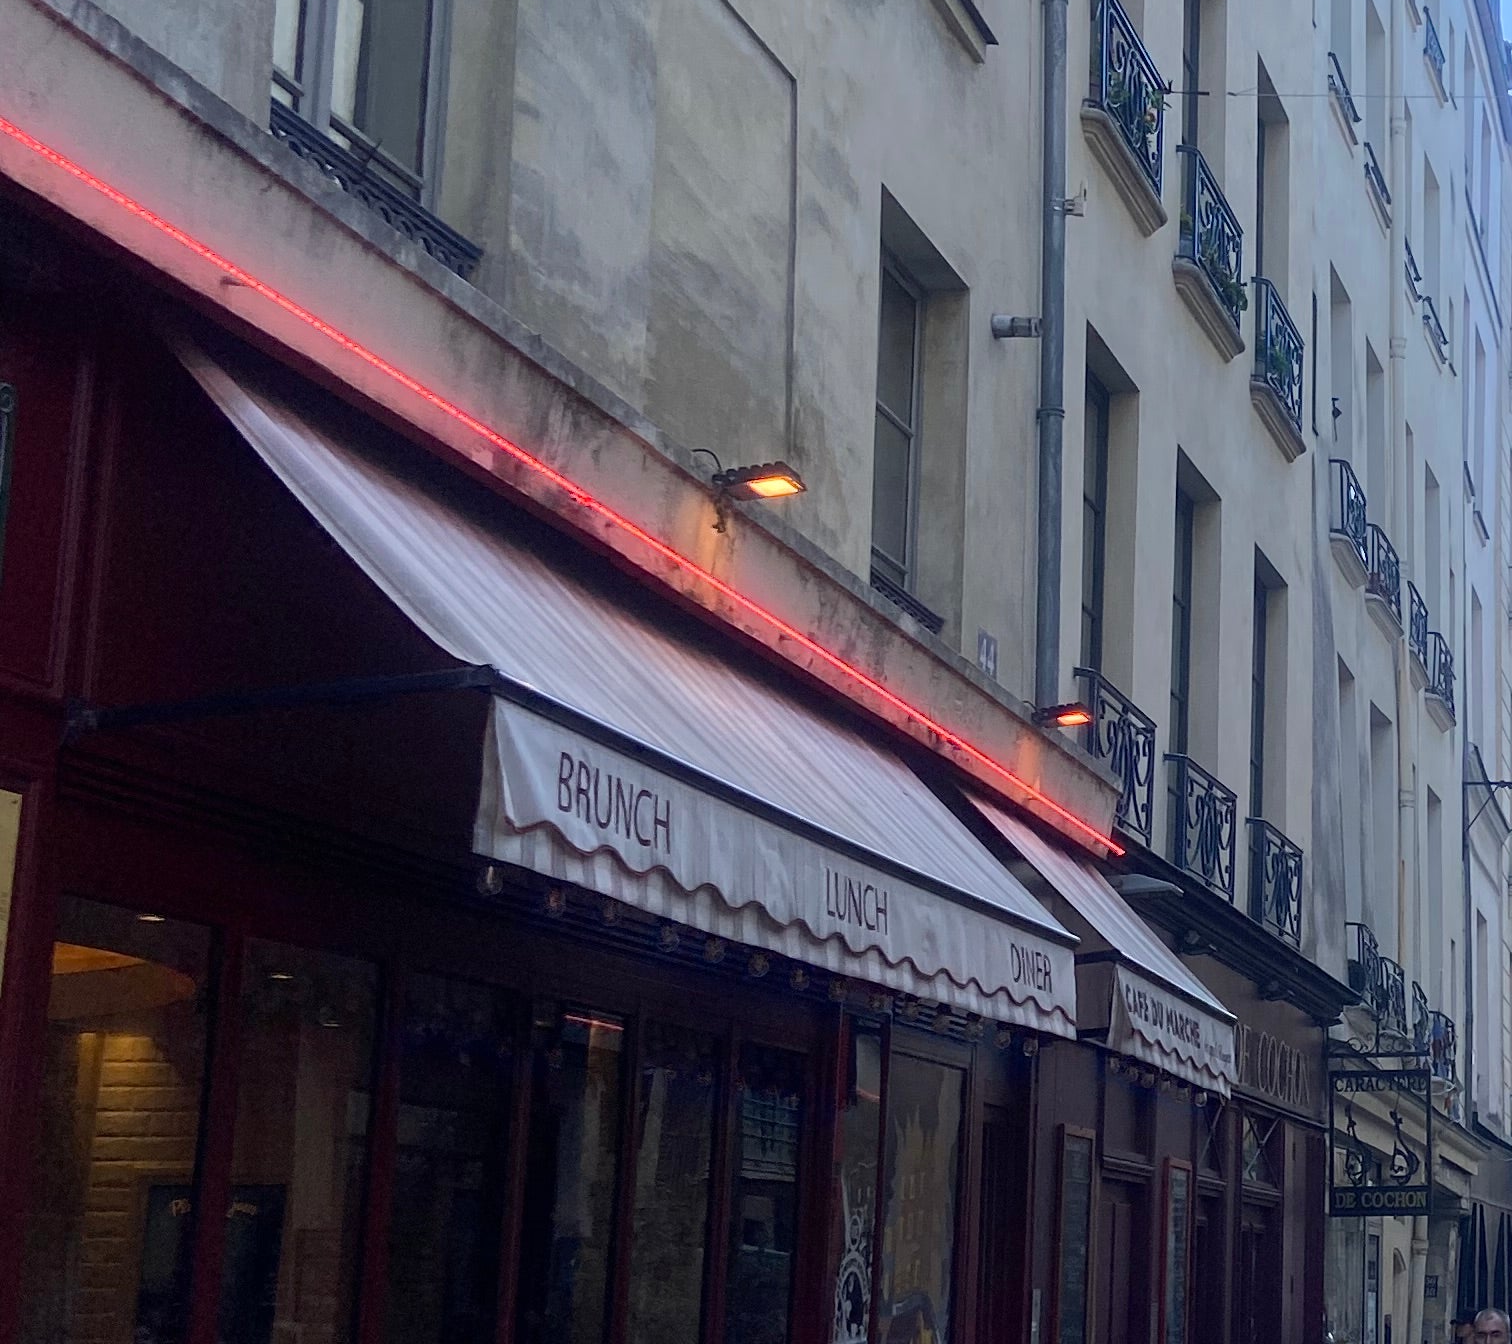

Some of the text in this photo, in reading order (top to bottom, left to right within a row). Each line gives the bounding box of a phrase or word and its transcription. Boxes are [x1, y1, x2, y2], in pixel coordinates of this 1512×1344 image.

[557, 750, 671, 855] BRUNCH
[825, 866, 889, 936] LUNCH
[1009, 942, 1054, 994] DINER
[1150, 996, 1165, 1031] DU
[1257, 1030, 1312, 1106] COCHON
[1335, 1191, 1427, 1209] DE COCHON
